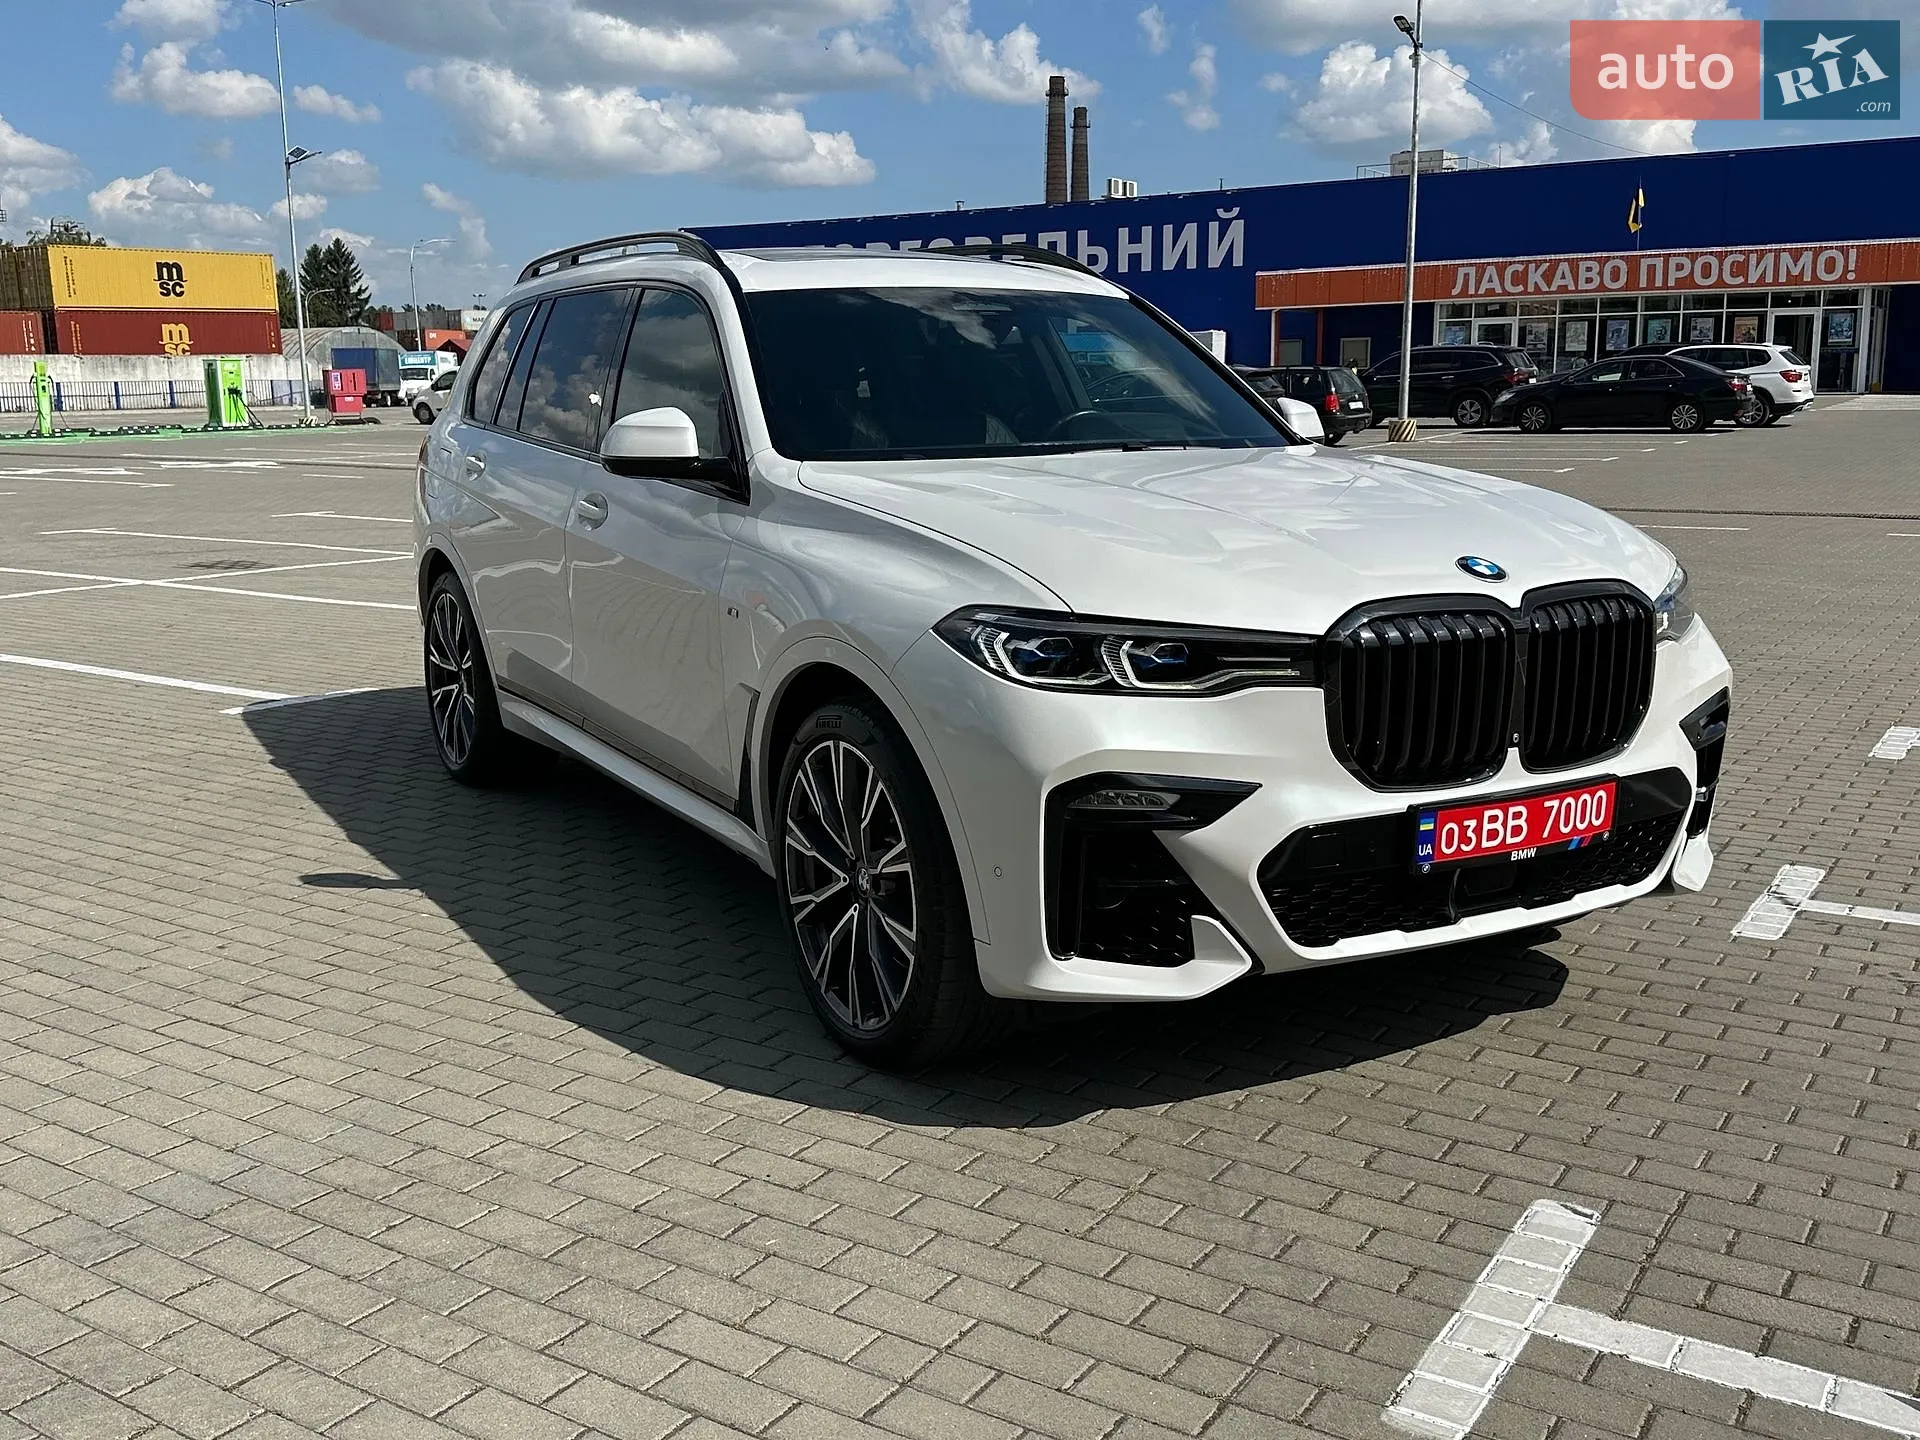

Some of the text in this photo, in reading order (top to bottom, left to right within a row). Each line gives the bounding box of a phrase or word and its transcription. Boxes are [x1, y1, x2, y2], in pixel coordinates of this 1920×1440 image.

[1451, 247, 1858, 297] ЛАСКАВО ПРОСИМО!
[1541, 789, 1608, 839] 7000
[1418, 844, 1433, 857] UA
[1510, 847, 1537, 862] BMW
